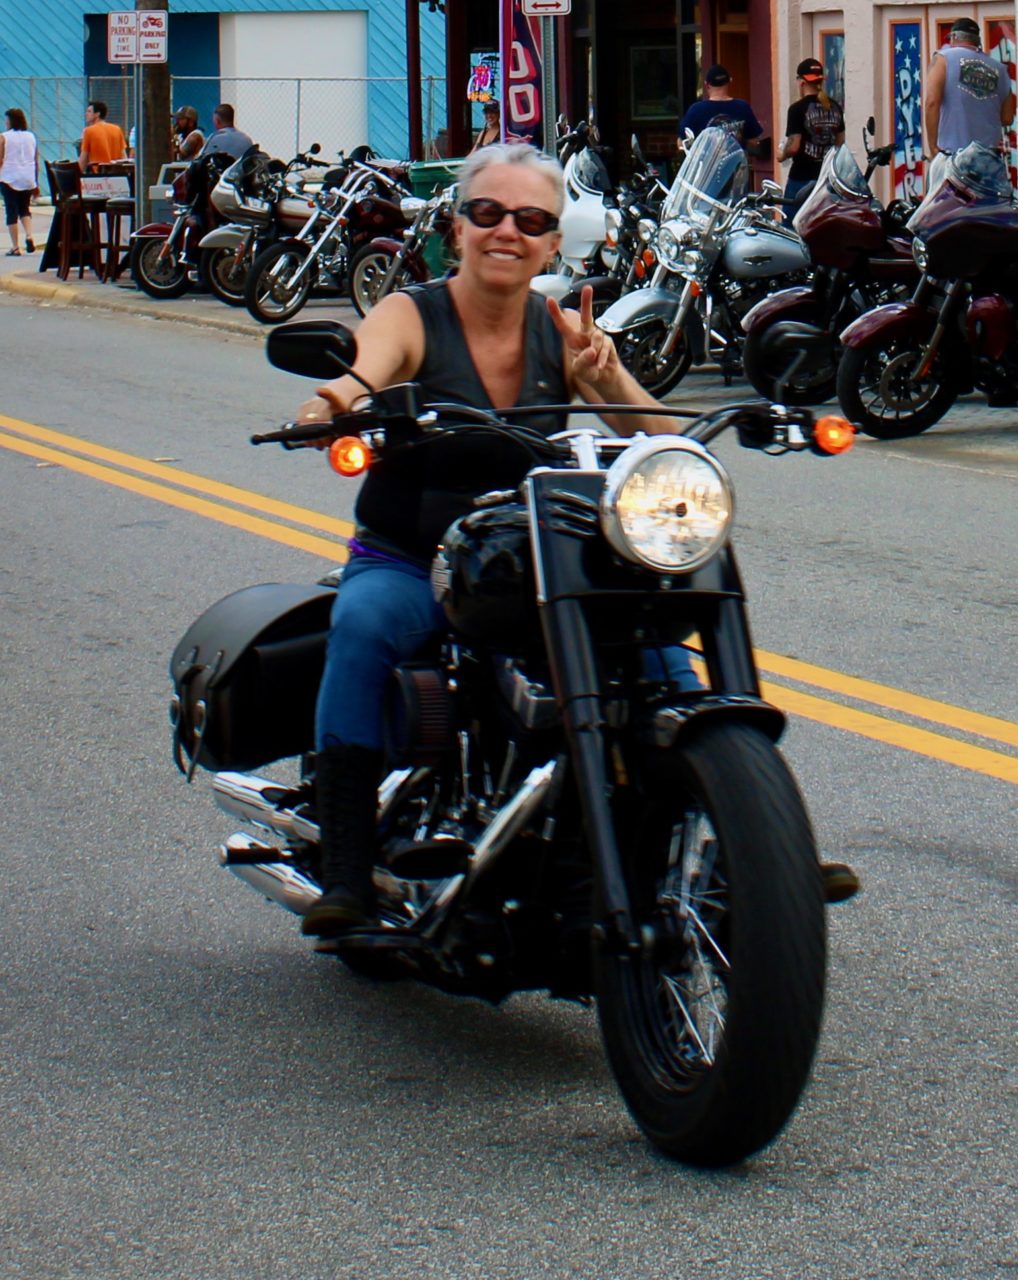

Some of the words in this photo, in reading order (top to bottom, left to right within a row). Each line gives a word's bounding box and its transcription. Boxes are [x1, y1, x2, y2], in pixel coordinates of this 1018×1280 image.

[117, 15, 129, 24] NO
[111, 26, 136, 36] PARKING
[139, 30, 167, 38] PARKING
